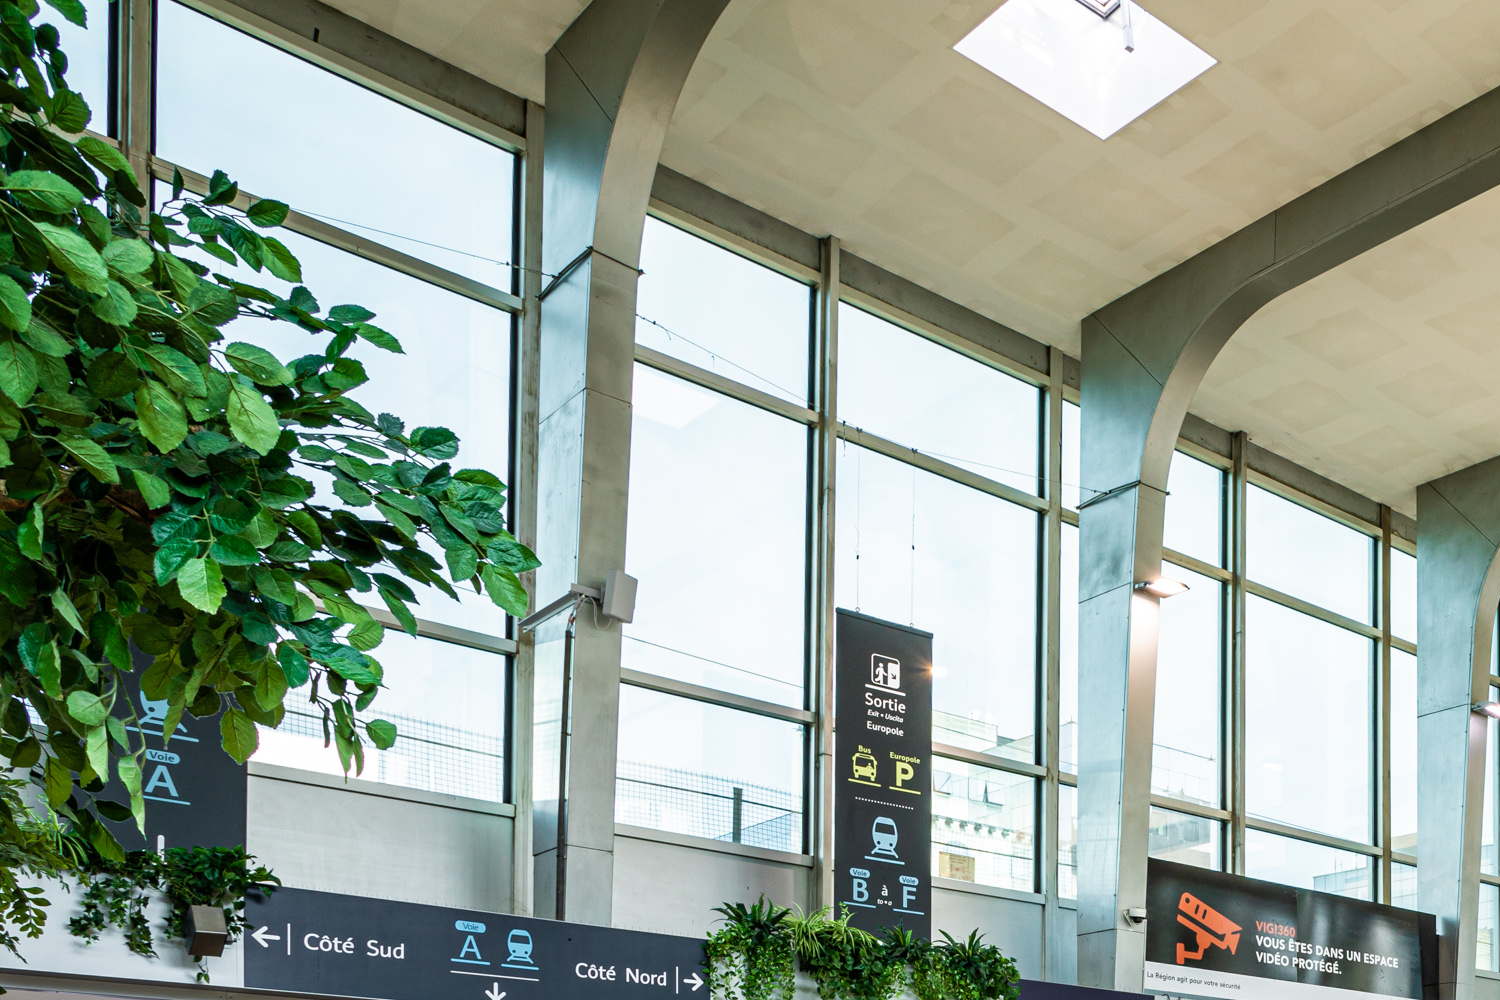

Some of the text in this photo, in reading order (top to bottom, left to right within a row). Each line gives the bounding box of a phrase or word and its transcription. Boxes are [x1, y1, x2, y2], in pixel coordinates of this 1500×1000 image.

[865, 692, 906, 713] Sortie
[868, 709, 904, 722] Exit Uscita
[866, 720, 904, 736] Europole
[150, 750, 176, 763] Voie
[858, 745, 872, 754] Bus
[890, 751, 920, 764] Europole
[144, 765, 179, 798] A
[896, 761, 914, 787] P
[852, 868, 868, 878] Voie
[902, 876, 916, 884] Voie
[852, 878, 916, 908] B à F
[462, 922, 480, 932] Voie
[1256, 920, 1296, 938] VIGI360
[303, 932, 405, 960] Côté Sud
[460, 935, 482, 960] A
[1256, 935, 1398, 968] VOUS ÊTES DANS UN ESPACE
[1256, 950, 1342, 974] VIDÉO PROTÉGÉ.
[575, 962, 667, 986] Côté Nord
[1156, 972, 1176, 982] Région
[1220, 982, 1240, 990] sécurité
